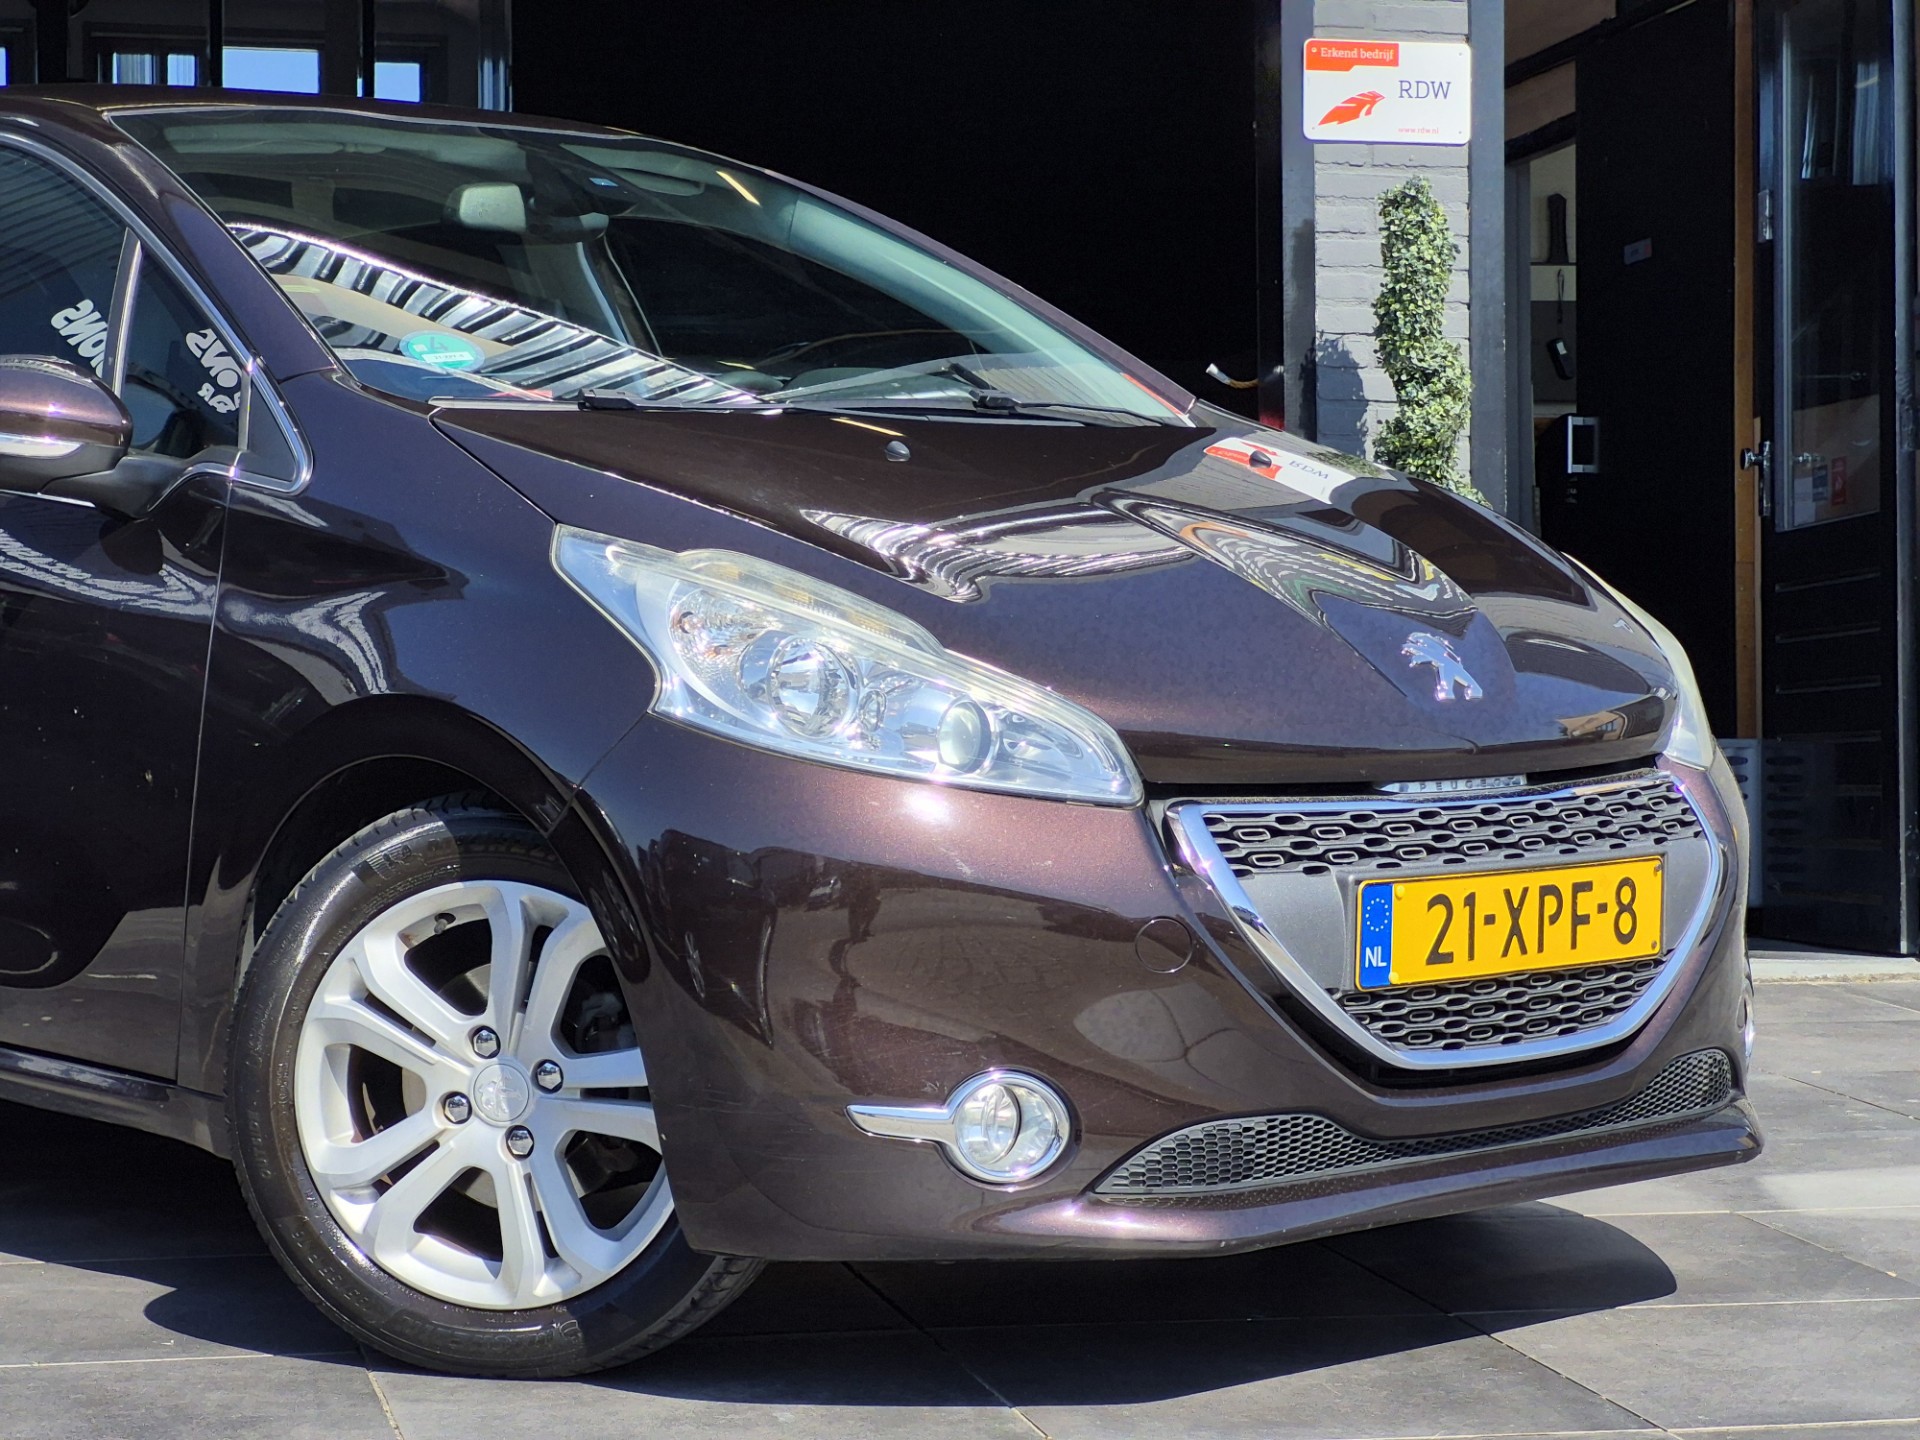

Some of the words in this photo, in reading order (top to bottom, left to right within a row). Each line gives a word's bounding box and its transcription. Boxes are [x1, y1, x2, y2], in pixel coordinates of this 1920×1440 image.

[1320, 47, 1358, 59] Erkend
[1360, 48, 1395, 62] bedrijf
[1398, 80, 1452, 100] RDW
[1420, 776, 1518, 792] PEUGEOT
[1425, 876, 1638, 966] 21-XPF-8
[1364, 945, 1388, 968] NL
